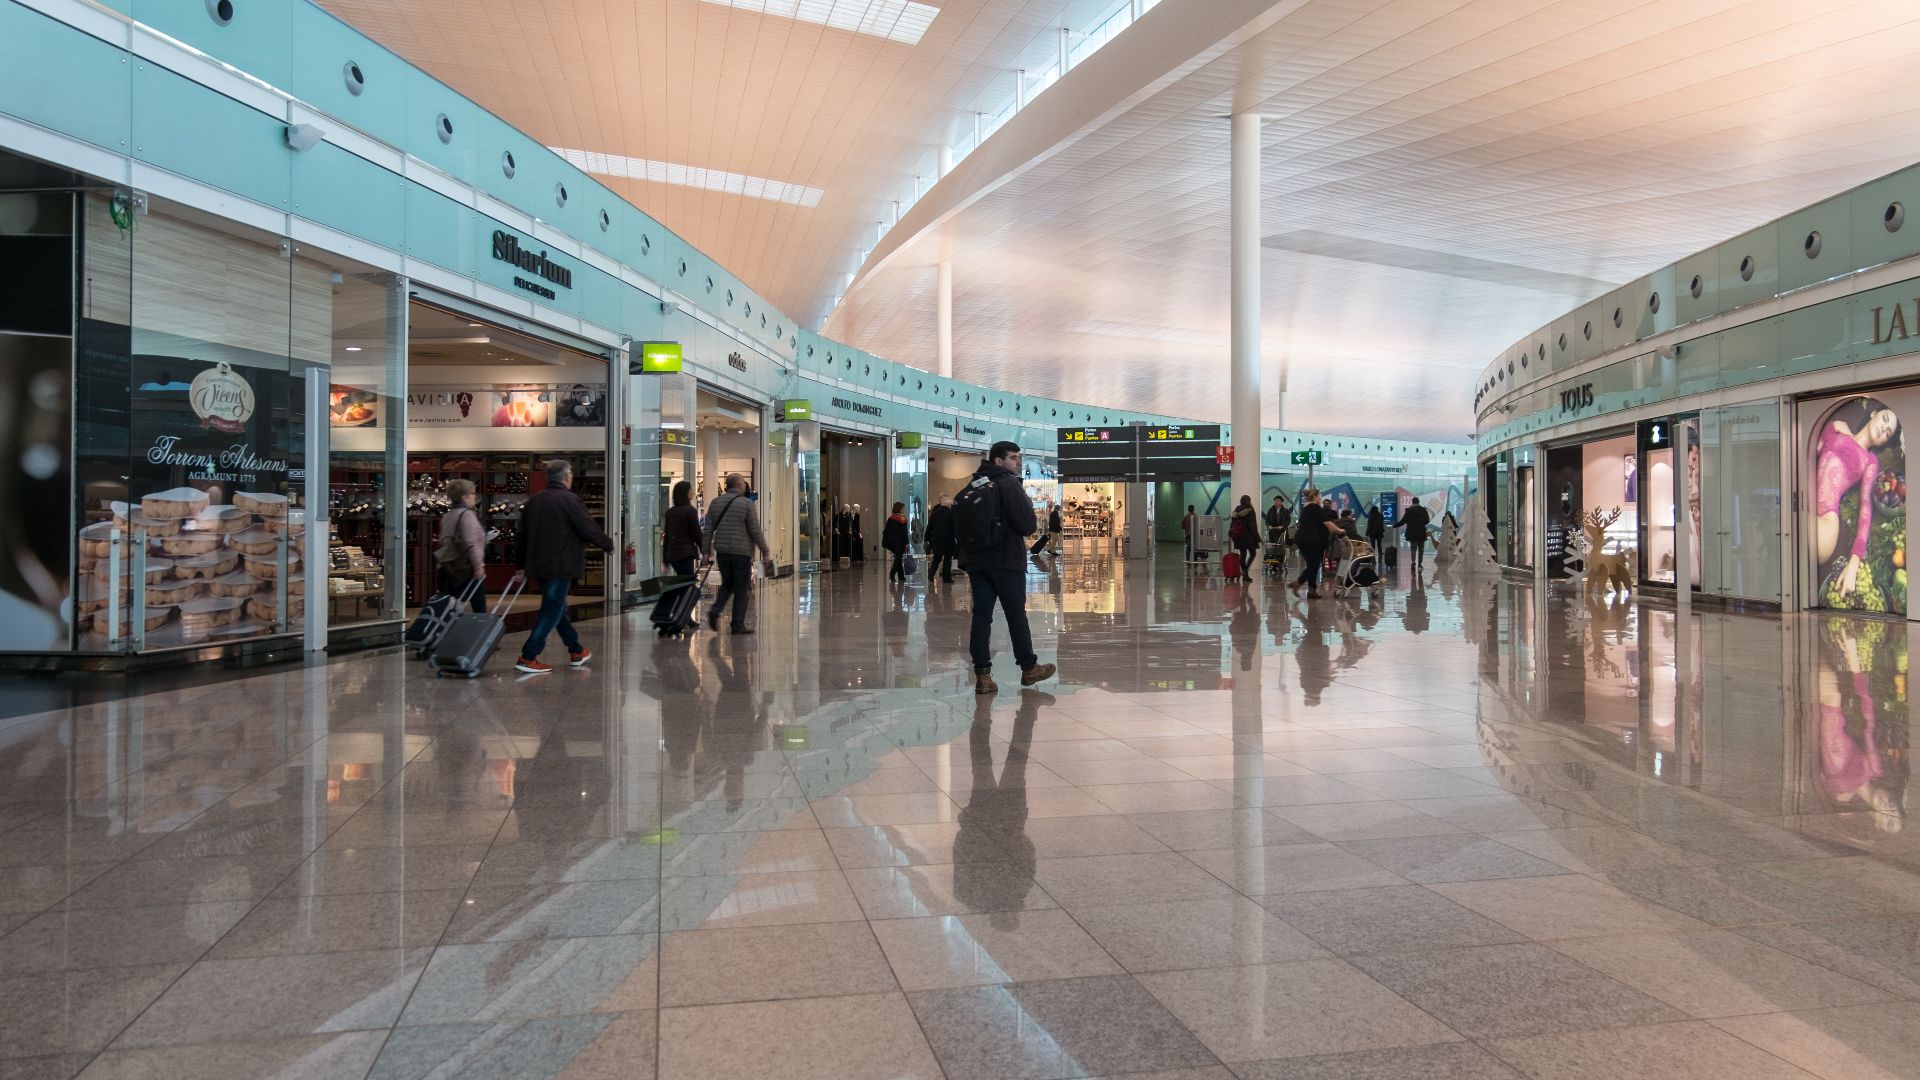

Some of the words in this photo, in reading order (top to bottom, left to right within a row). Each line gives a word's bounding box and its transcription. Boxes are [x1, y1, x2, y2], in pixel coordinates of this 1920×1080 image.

[493, 230, 572, 289] Sibarium
[195, 384, 250, 417] Vicens
[831, 396, 851, 410] ADOLFO
[1560, 383, 1594, 413] TOUS
[147, 435, 215, 466] Torrons
[219, 443, 289, 471] Artesans
[188, 471, 237, 482] AGRAMUNT
[239, 474, 256, 483] 1775
